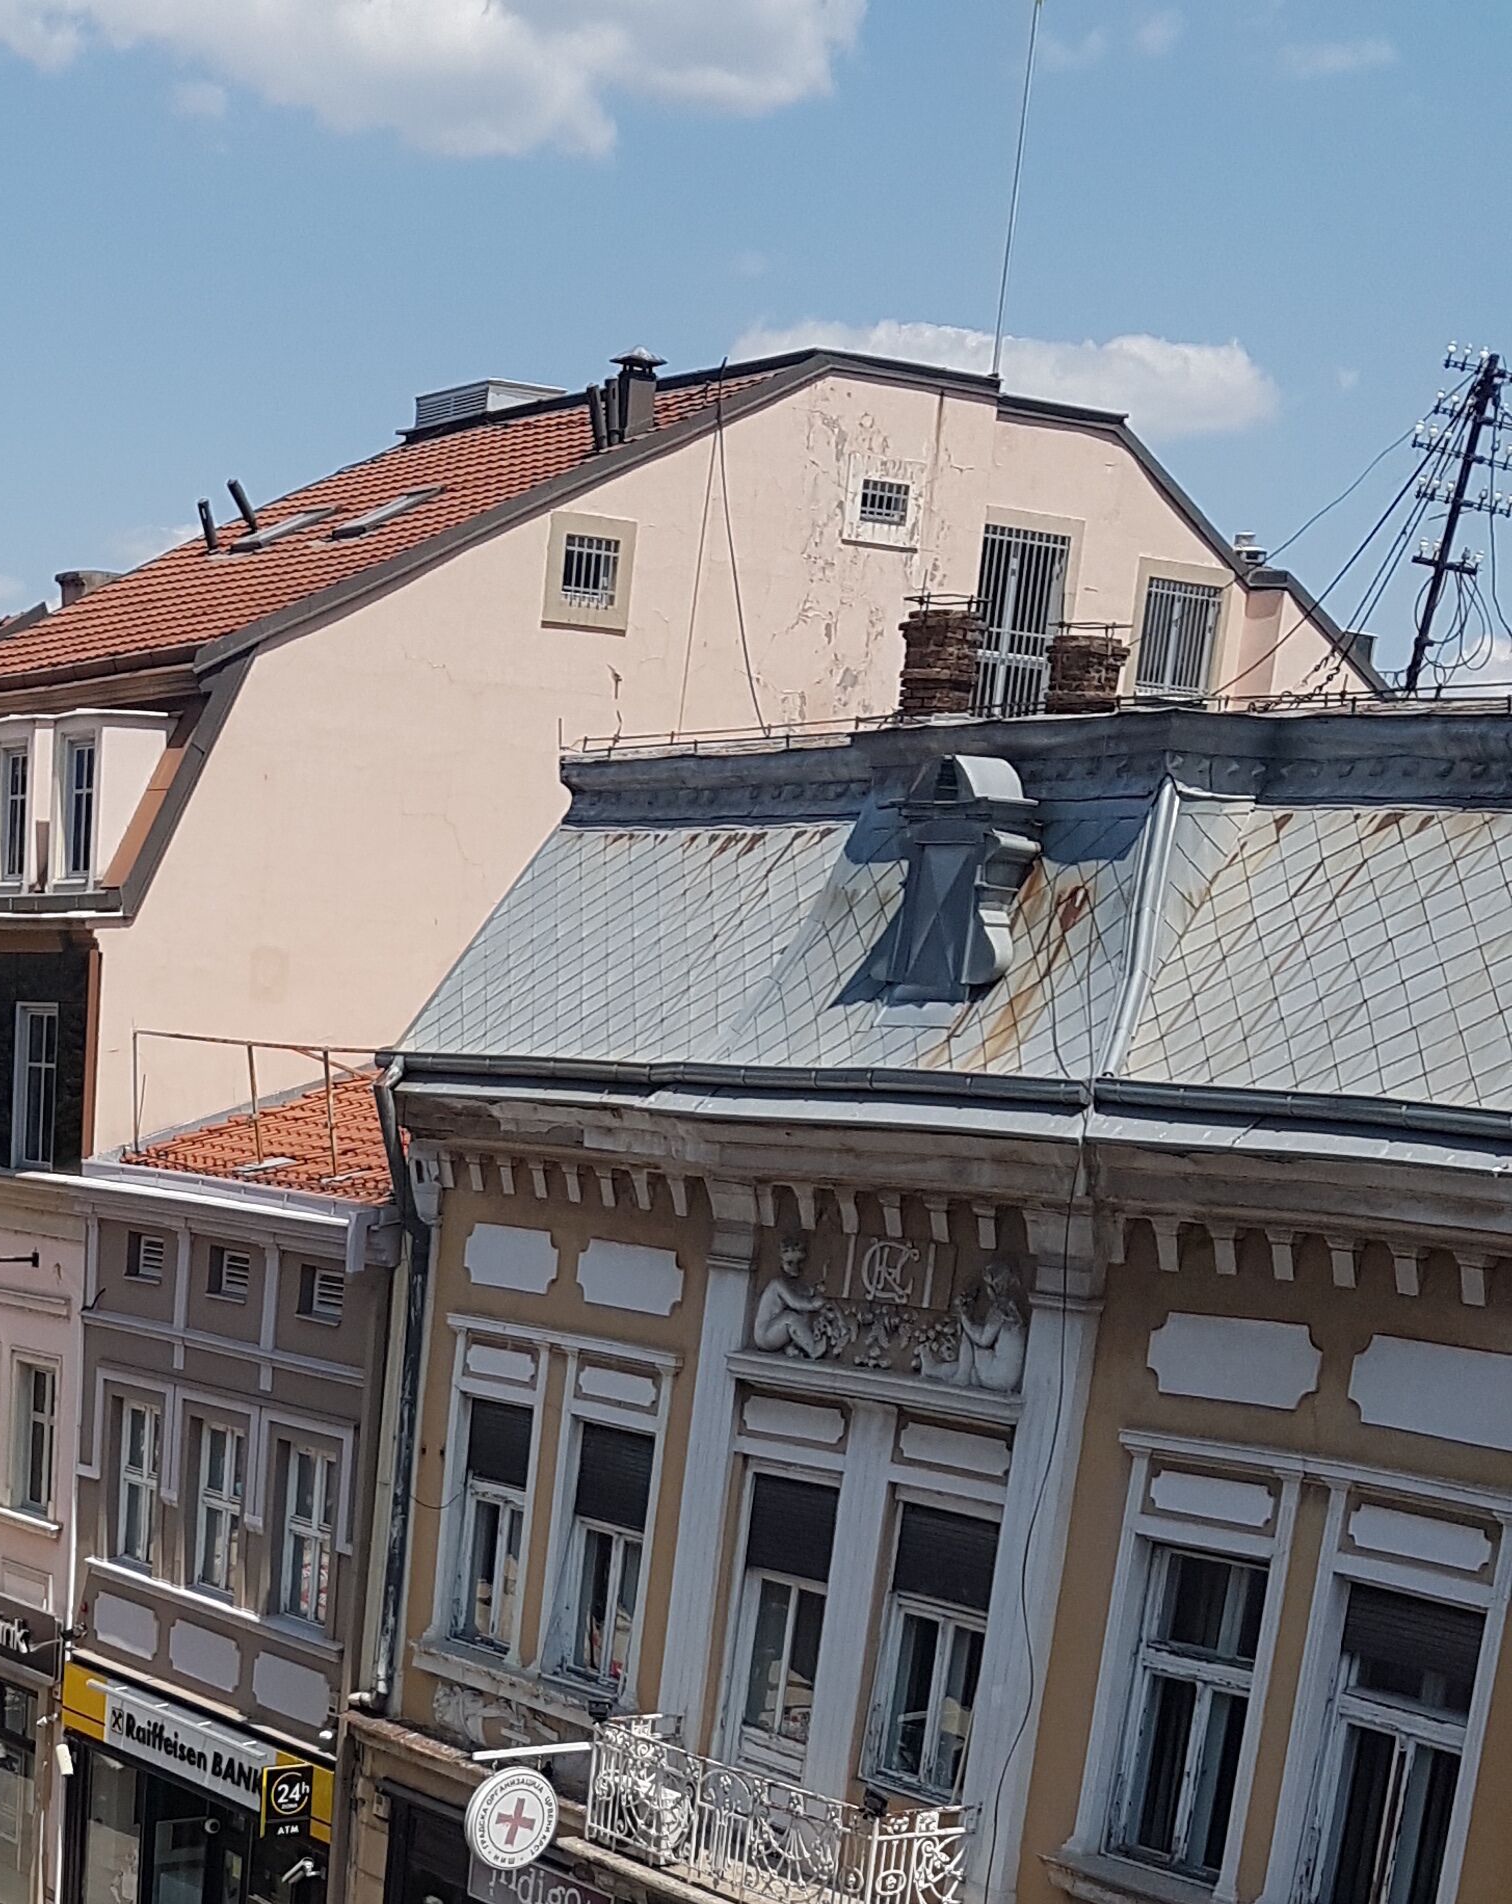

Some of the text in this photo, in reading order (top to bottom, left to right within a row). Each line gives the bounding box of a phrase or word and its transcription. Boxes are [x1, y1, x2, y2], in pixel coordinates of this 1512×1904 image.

[125, 1712, 208, 1774] Raiffeisen
[276, 1781, 310, 1805] 24h
[277, 1824, 300, 1836] ATM
